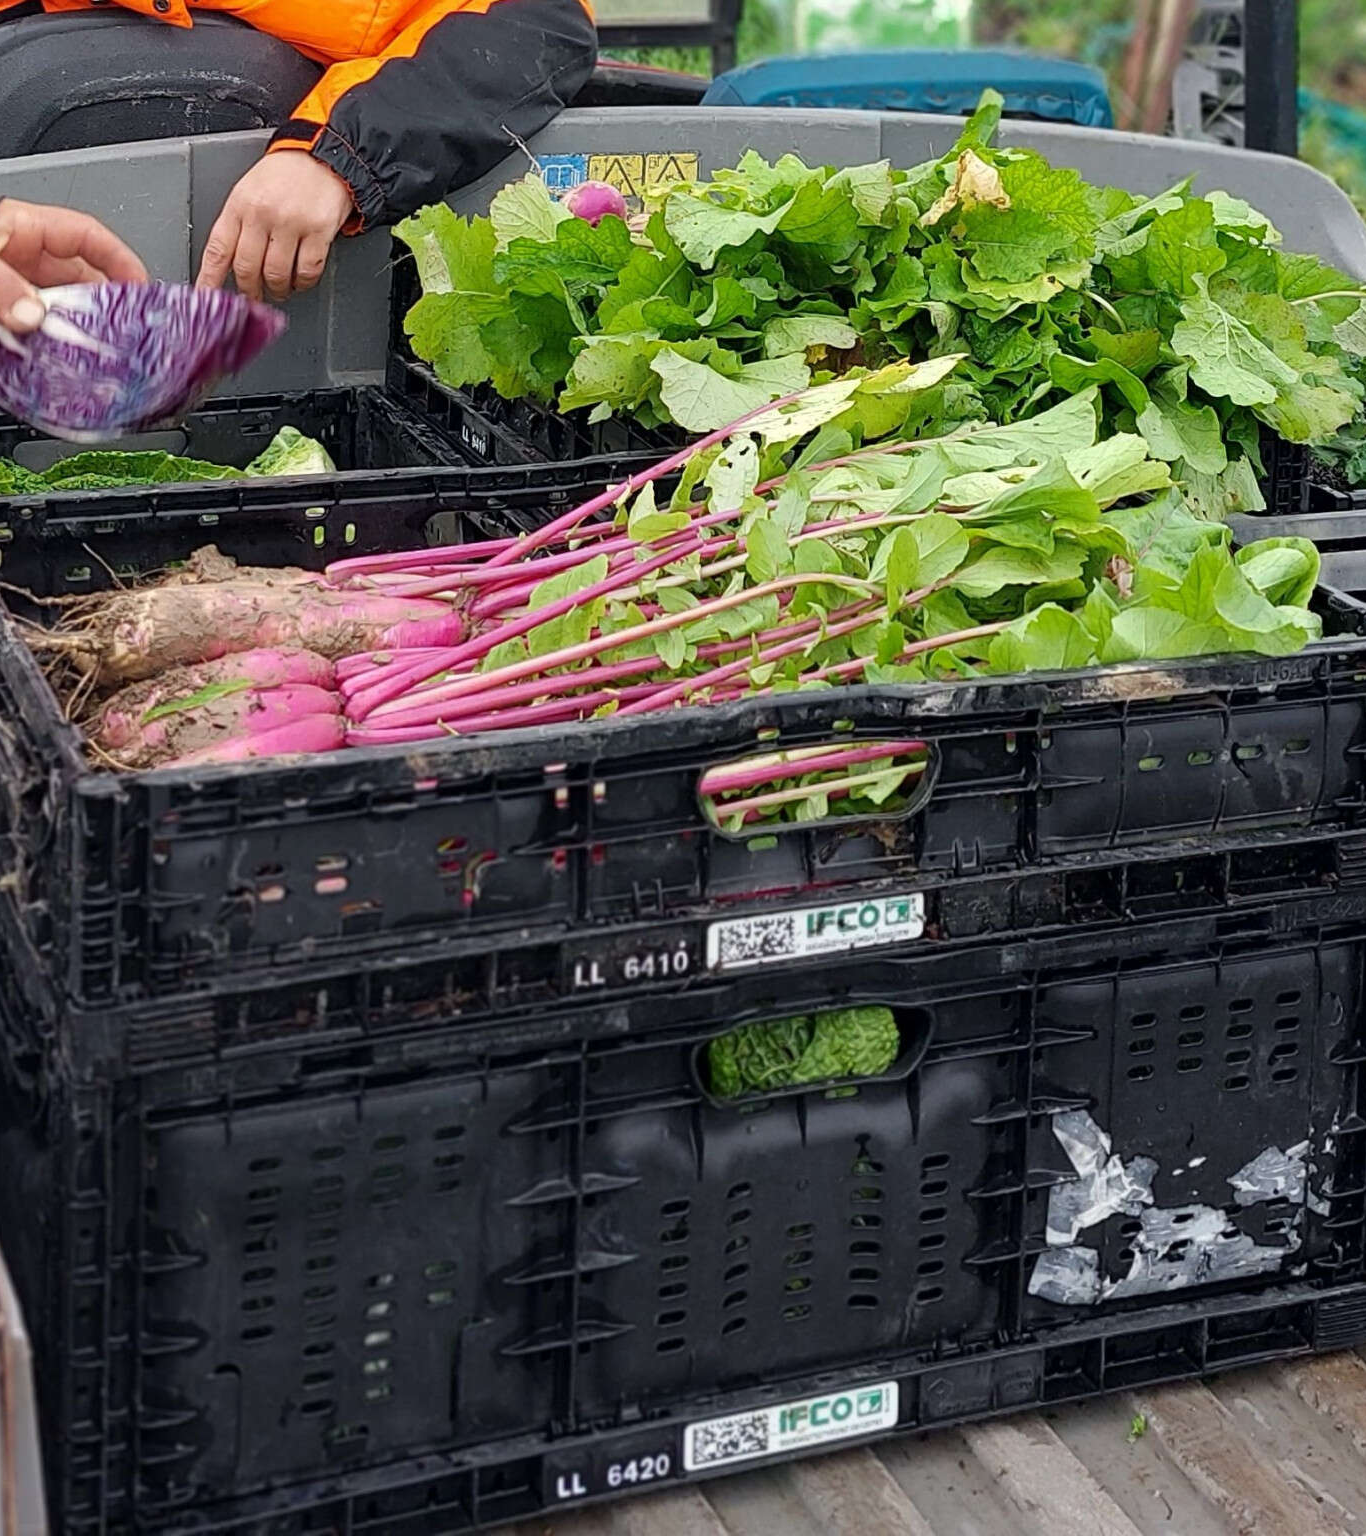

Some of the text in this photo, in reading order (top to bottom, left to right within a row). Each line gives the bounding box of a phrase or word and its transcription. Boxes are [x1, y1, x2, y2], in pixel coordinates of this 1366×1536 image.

[807, 904, 880, 938] IFCO
[575, 951, 689, 986] LL 6410
[779, 1396, 853, 1433] IFCO
[557, 1453, 670, 1498] LL 6420
